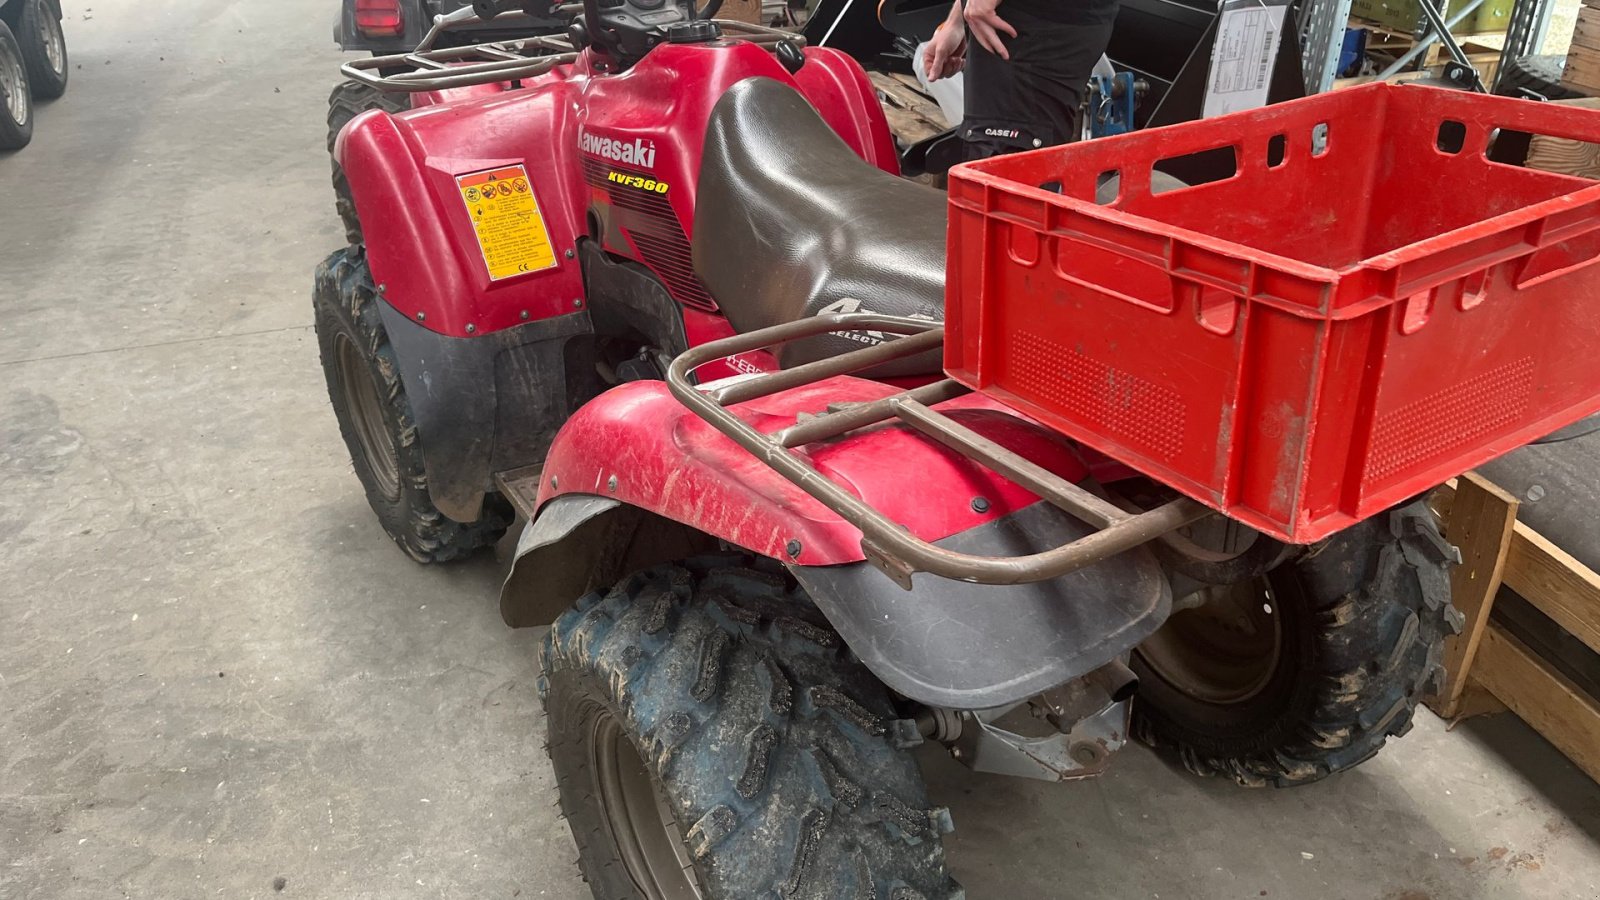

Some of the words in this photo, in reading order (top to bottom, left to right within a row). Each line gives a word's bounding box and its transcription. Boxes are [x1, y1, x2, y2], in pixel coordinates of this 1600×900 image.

[985, 128, 1010, 138] CASE
[577, 123, 656, 169] Kawasaki
[607, 171, 669, 194] KVF360
[828, 330, 886, 346] SELECT
